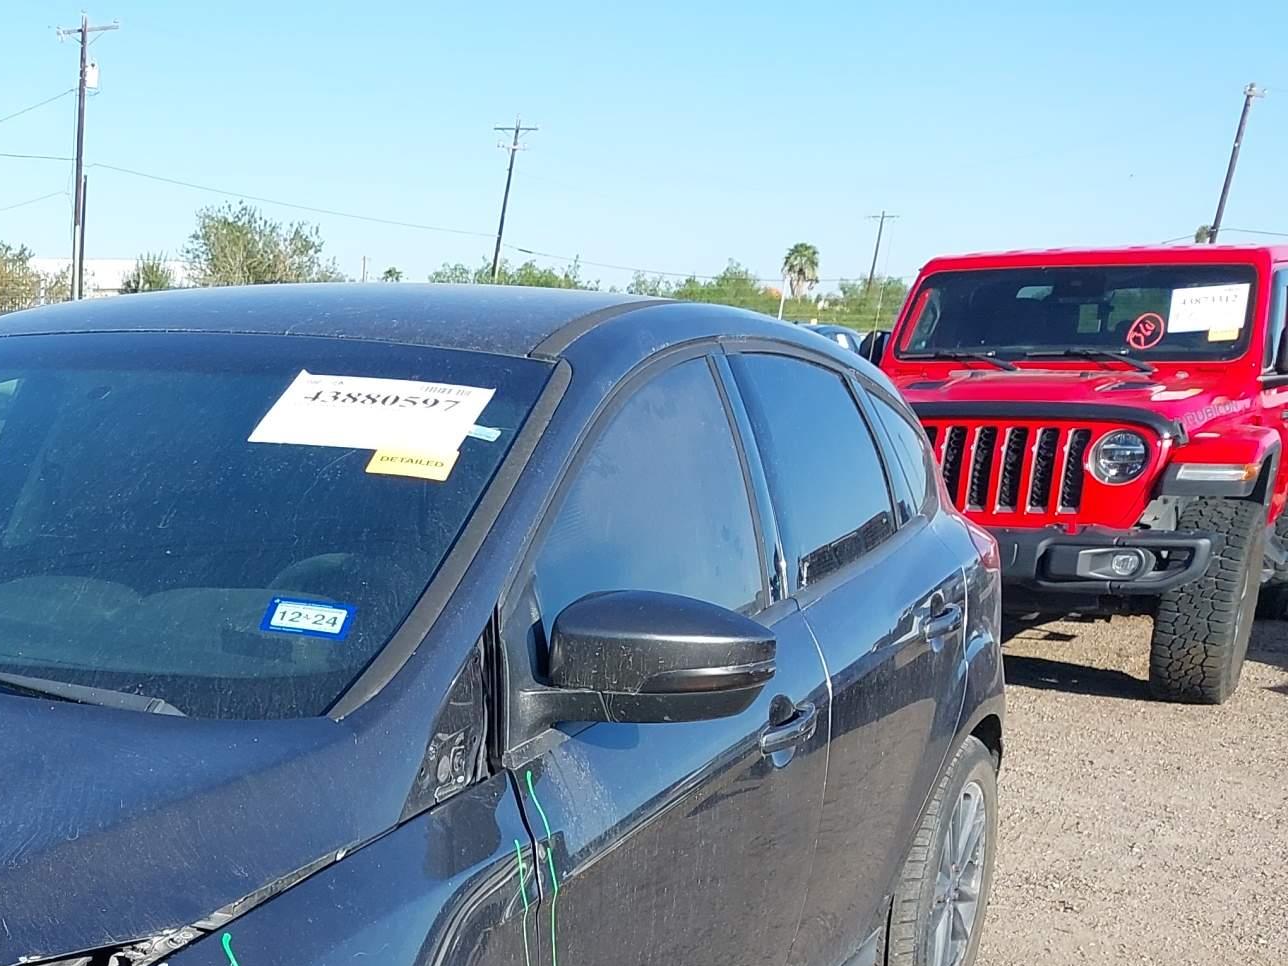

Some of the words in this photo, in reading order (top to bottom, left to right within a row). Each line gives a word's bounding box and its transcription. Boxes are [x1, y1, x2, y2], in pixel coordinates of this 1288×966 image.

[304, 390, 461, 412] 43880597
[1185, 402, 1238, 424] RUBICON
[379, 456, 445, 468] DETAILED
[279, 610, 303, 622] 12
[311, 613, 338, 627] 24
